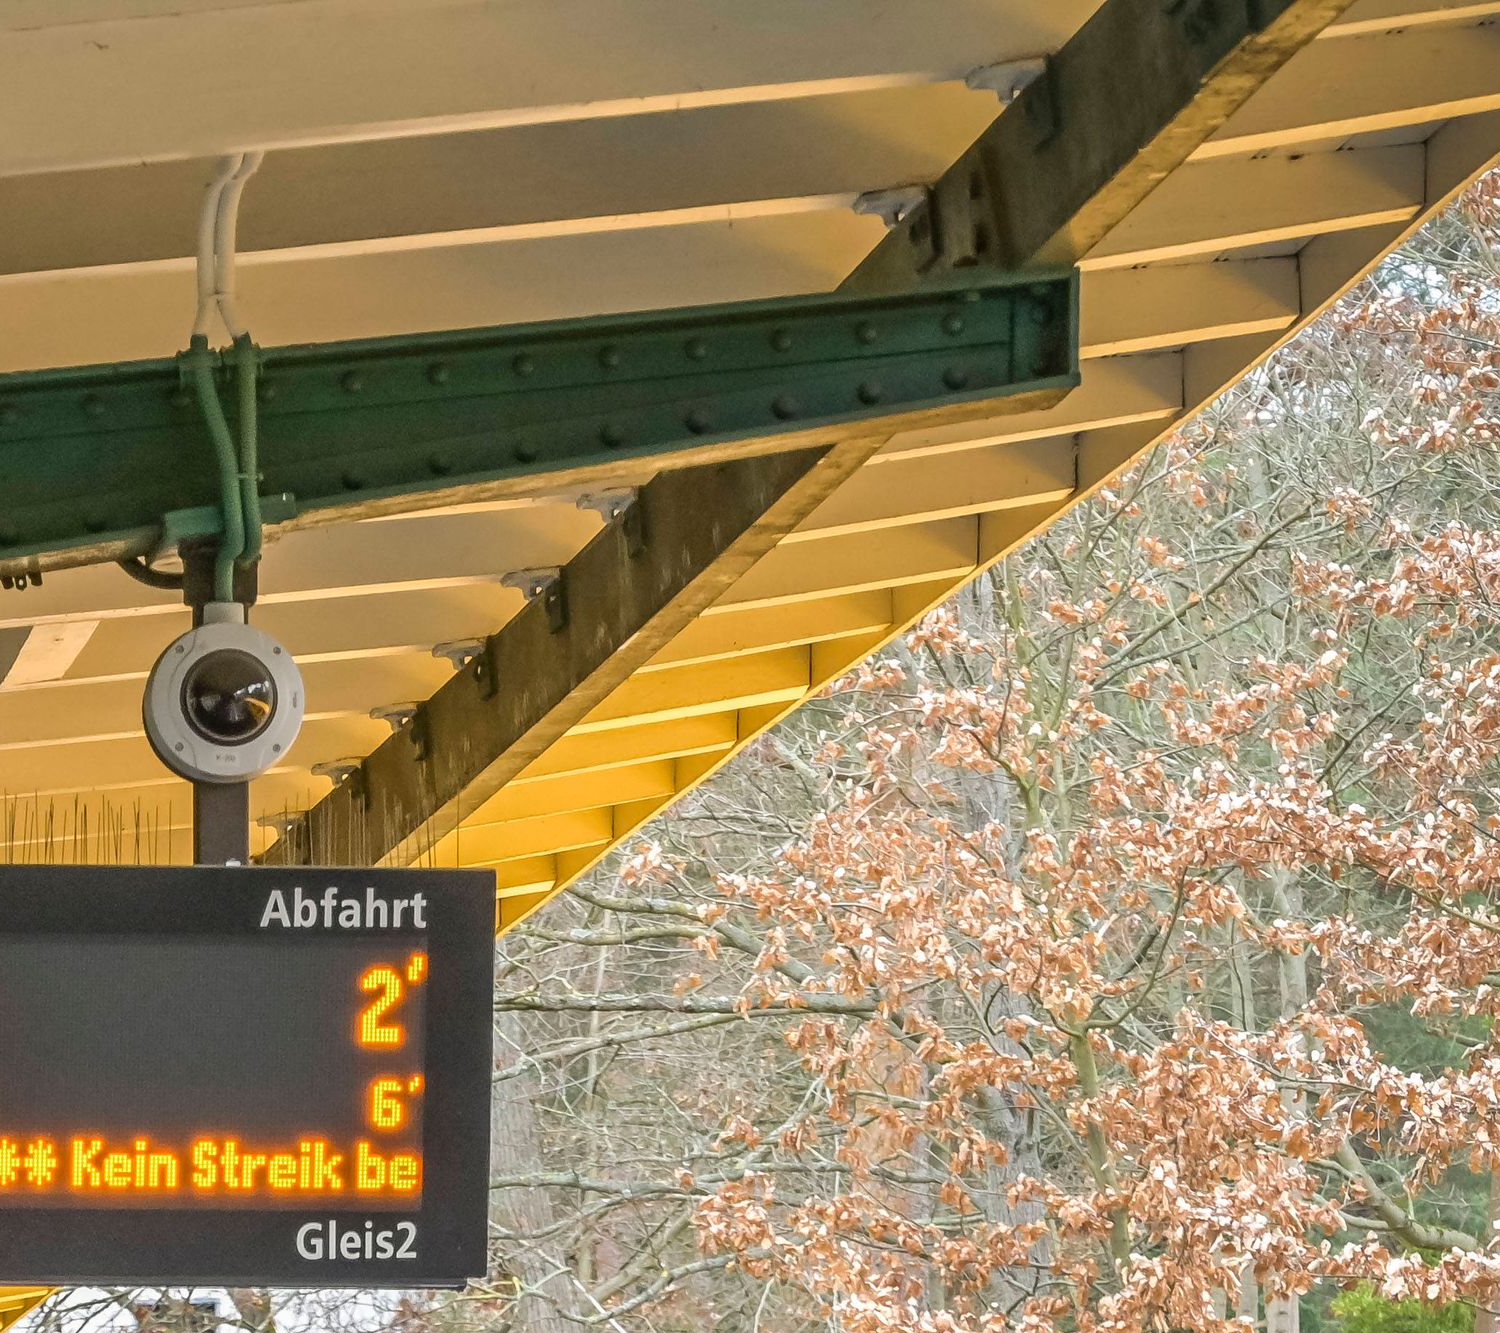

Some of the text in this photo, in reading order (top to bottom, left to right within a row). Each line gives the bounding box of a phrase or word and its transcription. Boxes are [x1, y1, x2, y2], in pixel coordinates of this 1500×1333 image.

[259, 887, 427, 928] Abfahrt
[72, 1139, 178, 1188] Kein
[193, 1140, 342, 1190] Streik
[357, 1142, 418, 1190] be
[296, 1222, 418, 1261] Gleis2
